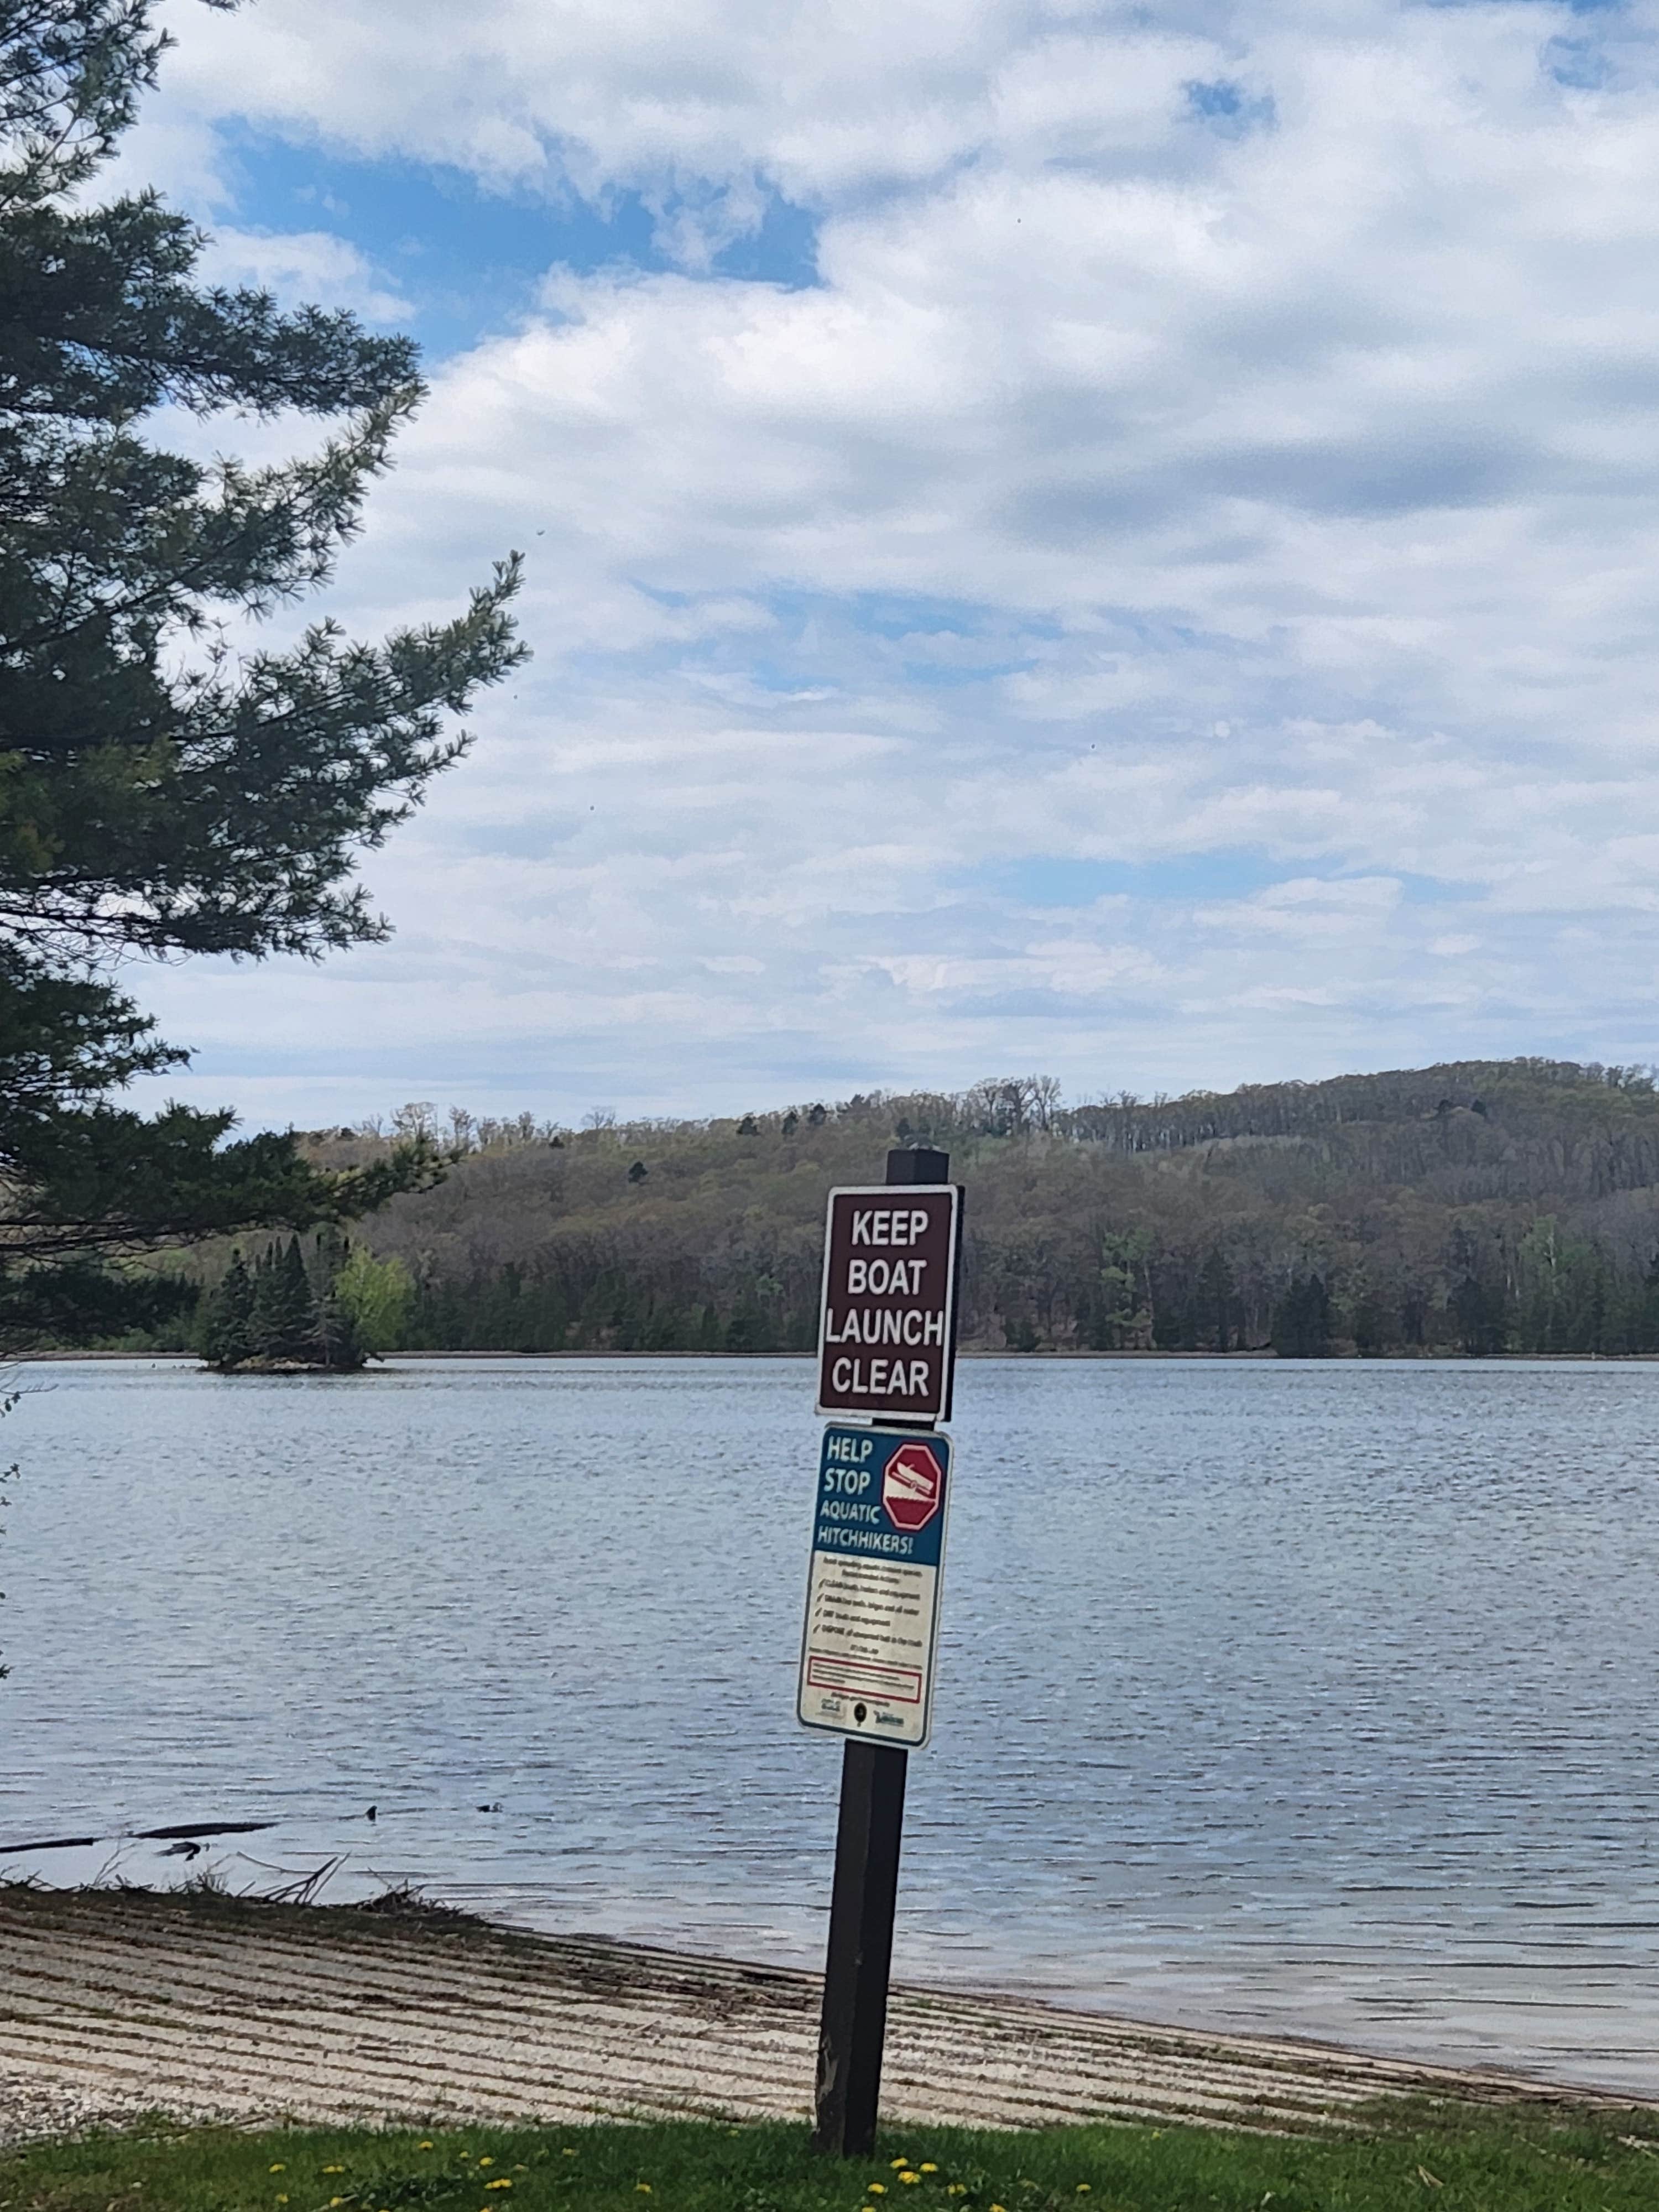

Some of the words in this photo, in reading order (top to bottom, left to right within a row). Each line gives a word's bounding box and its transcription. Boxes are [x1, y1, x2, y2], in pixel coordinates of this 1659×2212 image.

[852, 1210, 928, 1245] KEEP
[848, 1259, 927, 1295] BOAT
[826, 1308, 943, 1345] LAUNCH
[832, 1357, 929, 1397] CLEAR
[827, 1436, 873, 1463] HELP
[823, 1468, 871, 1495] STOP
[820, 1500, 881, 1525] AQUATIC
[817, 1526, 914, 1555] HITCHHIKERS!
